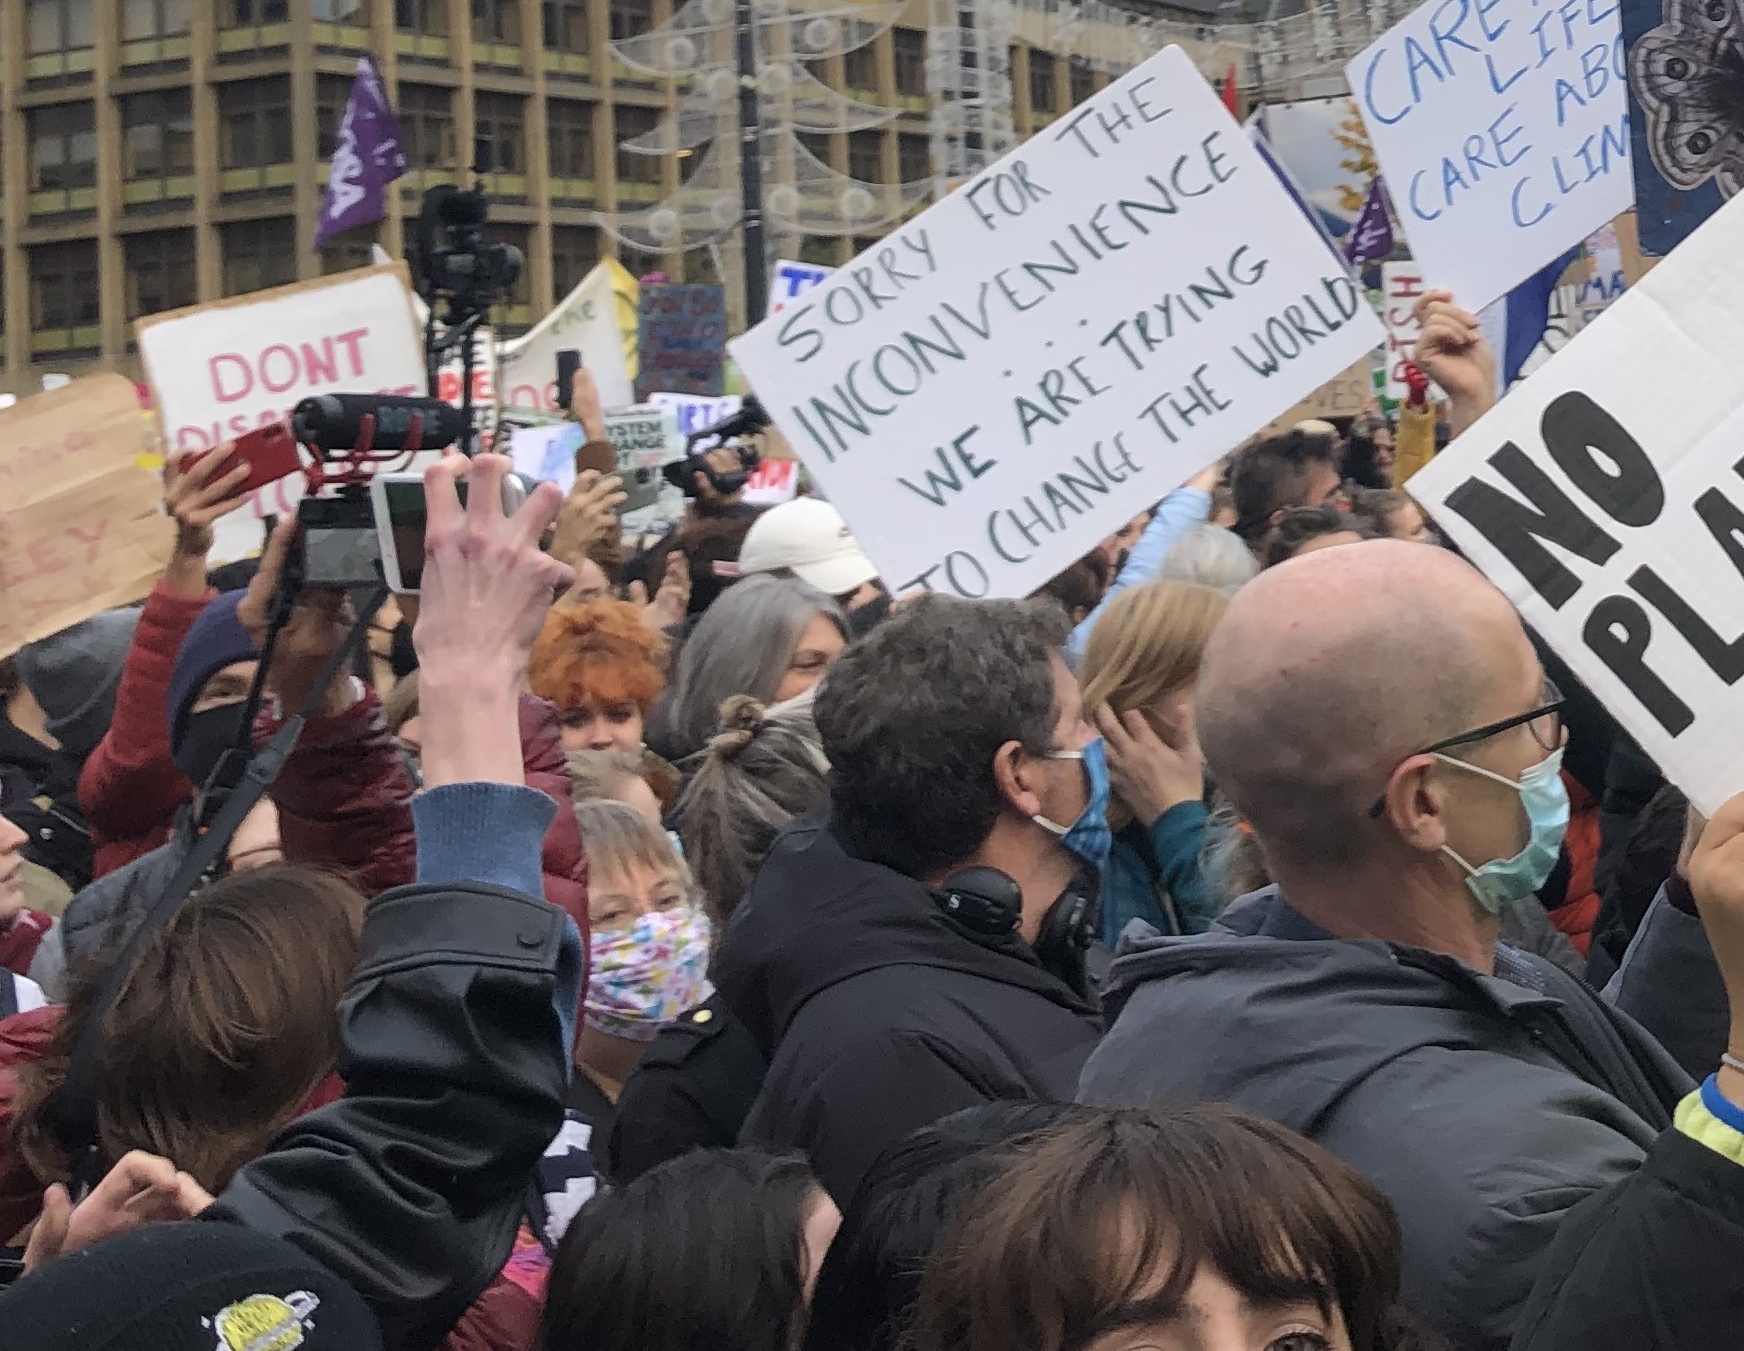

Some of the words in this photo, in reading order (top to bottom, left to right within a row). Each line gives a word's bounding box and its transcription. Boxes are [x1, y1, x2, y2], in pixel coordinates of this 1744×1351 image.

[778, 228, 938, 363] SORRY
[965, 158, 1052, 231] FOR
[1054, 76, 1173, 158] THE
[1409, 101, 1534, 221] CARE
[207, 326, 371, 403] DONT
[792, 129, 1239, 463] INCONVENIENCE
[896, 423, 998, 507] WE
[1013, 355, 1113, 446] ARE
[1099, 243, 1270, 371] TRYING
[897, 549, 991, 600] TO
[986, 429, 1145, 564] CHANGE
[1136, 362, 1234, 444] THE
[1231, 275, 1359, 378] WORLD
[1442, 389, 1666, 612] NO
